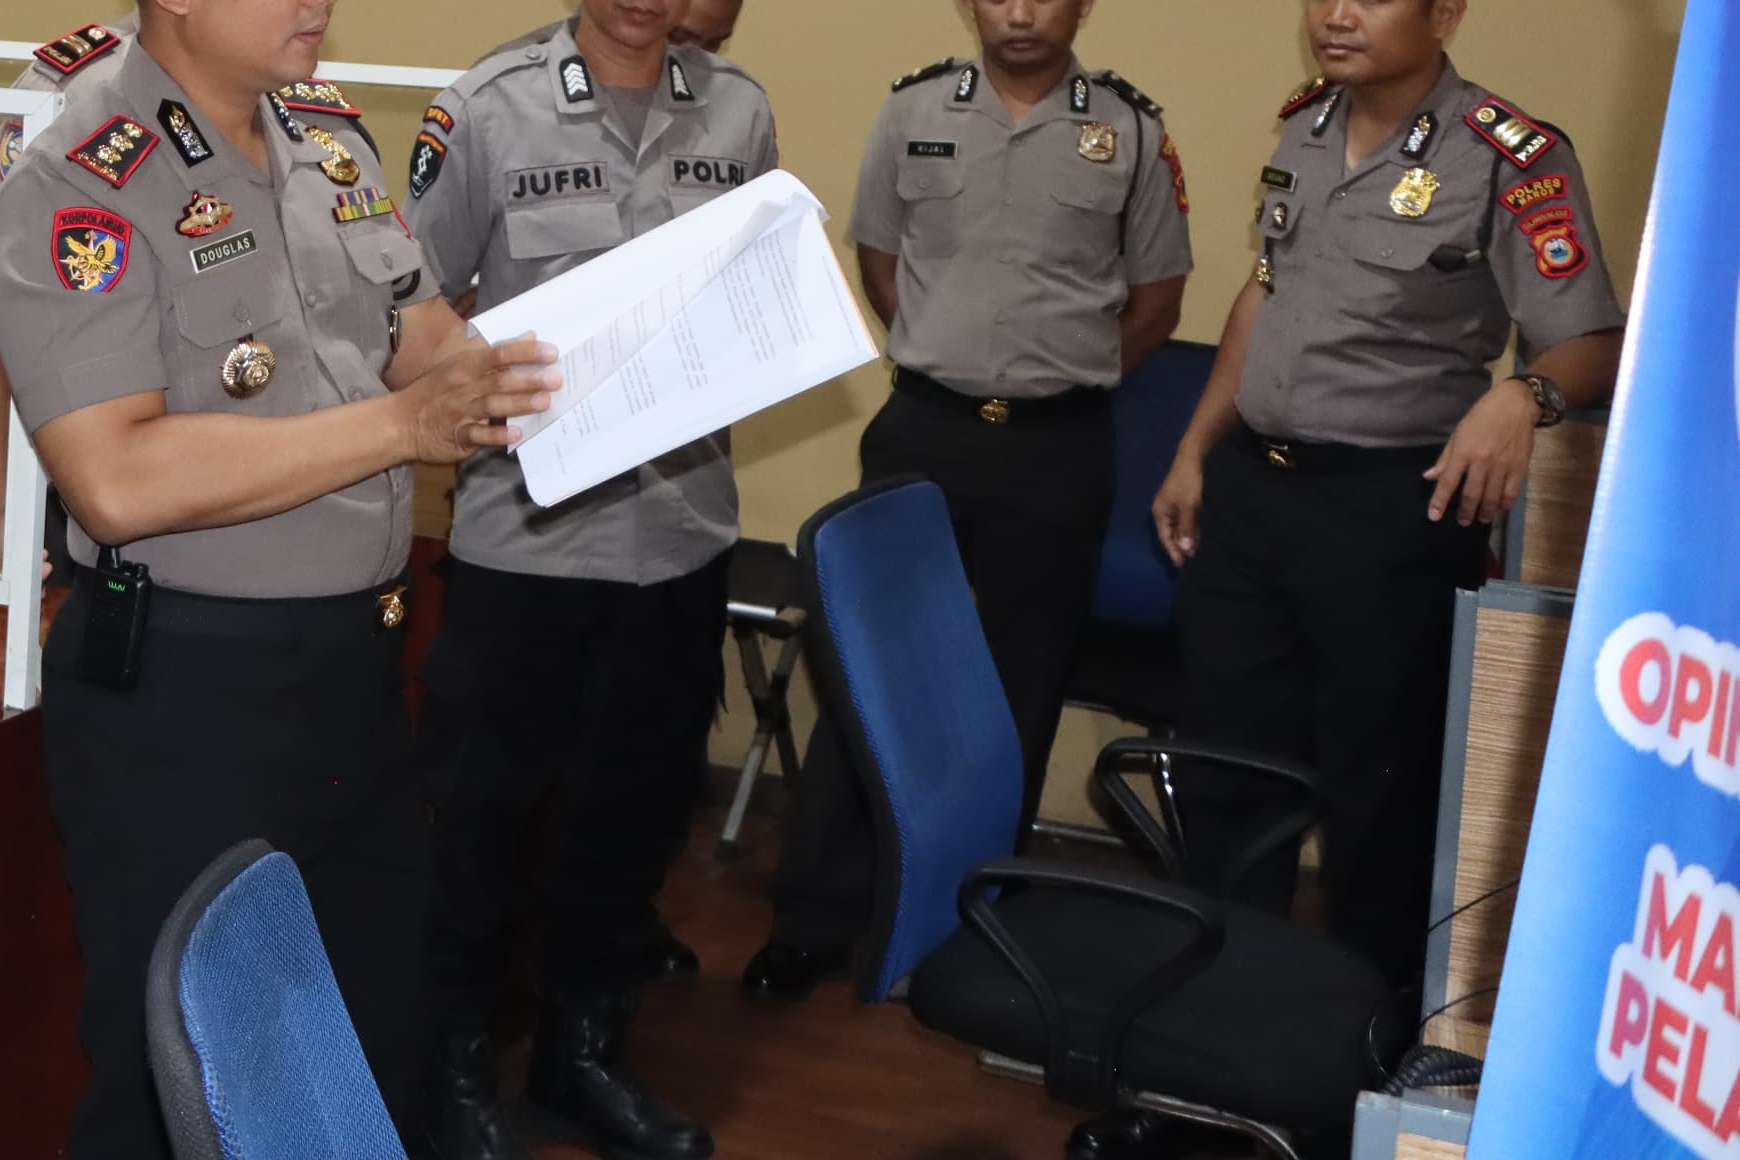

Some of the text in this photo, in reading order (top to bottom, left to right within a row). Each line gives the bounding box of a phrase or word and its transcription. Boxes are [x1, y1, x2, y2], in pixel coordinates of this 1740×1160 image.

[512, 164, 602, 199] JUFRI
[673, 158, 745, 186] POLRI
[1507, 177, 1562, 205] POLRES
[199, 237, 251, 265] DOUGLAS
[1641, 871, 1740, 1020] MA
